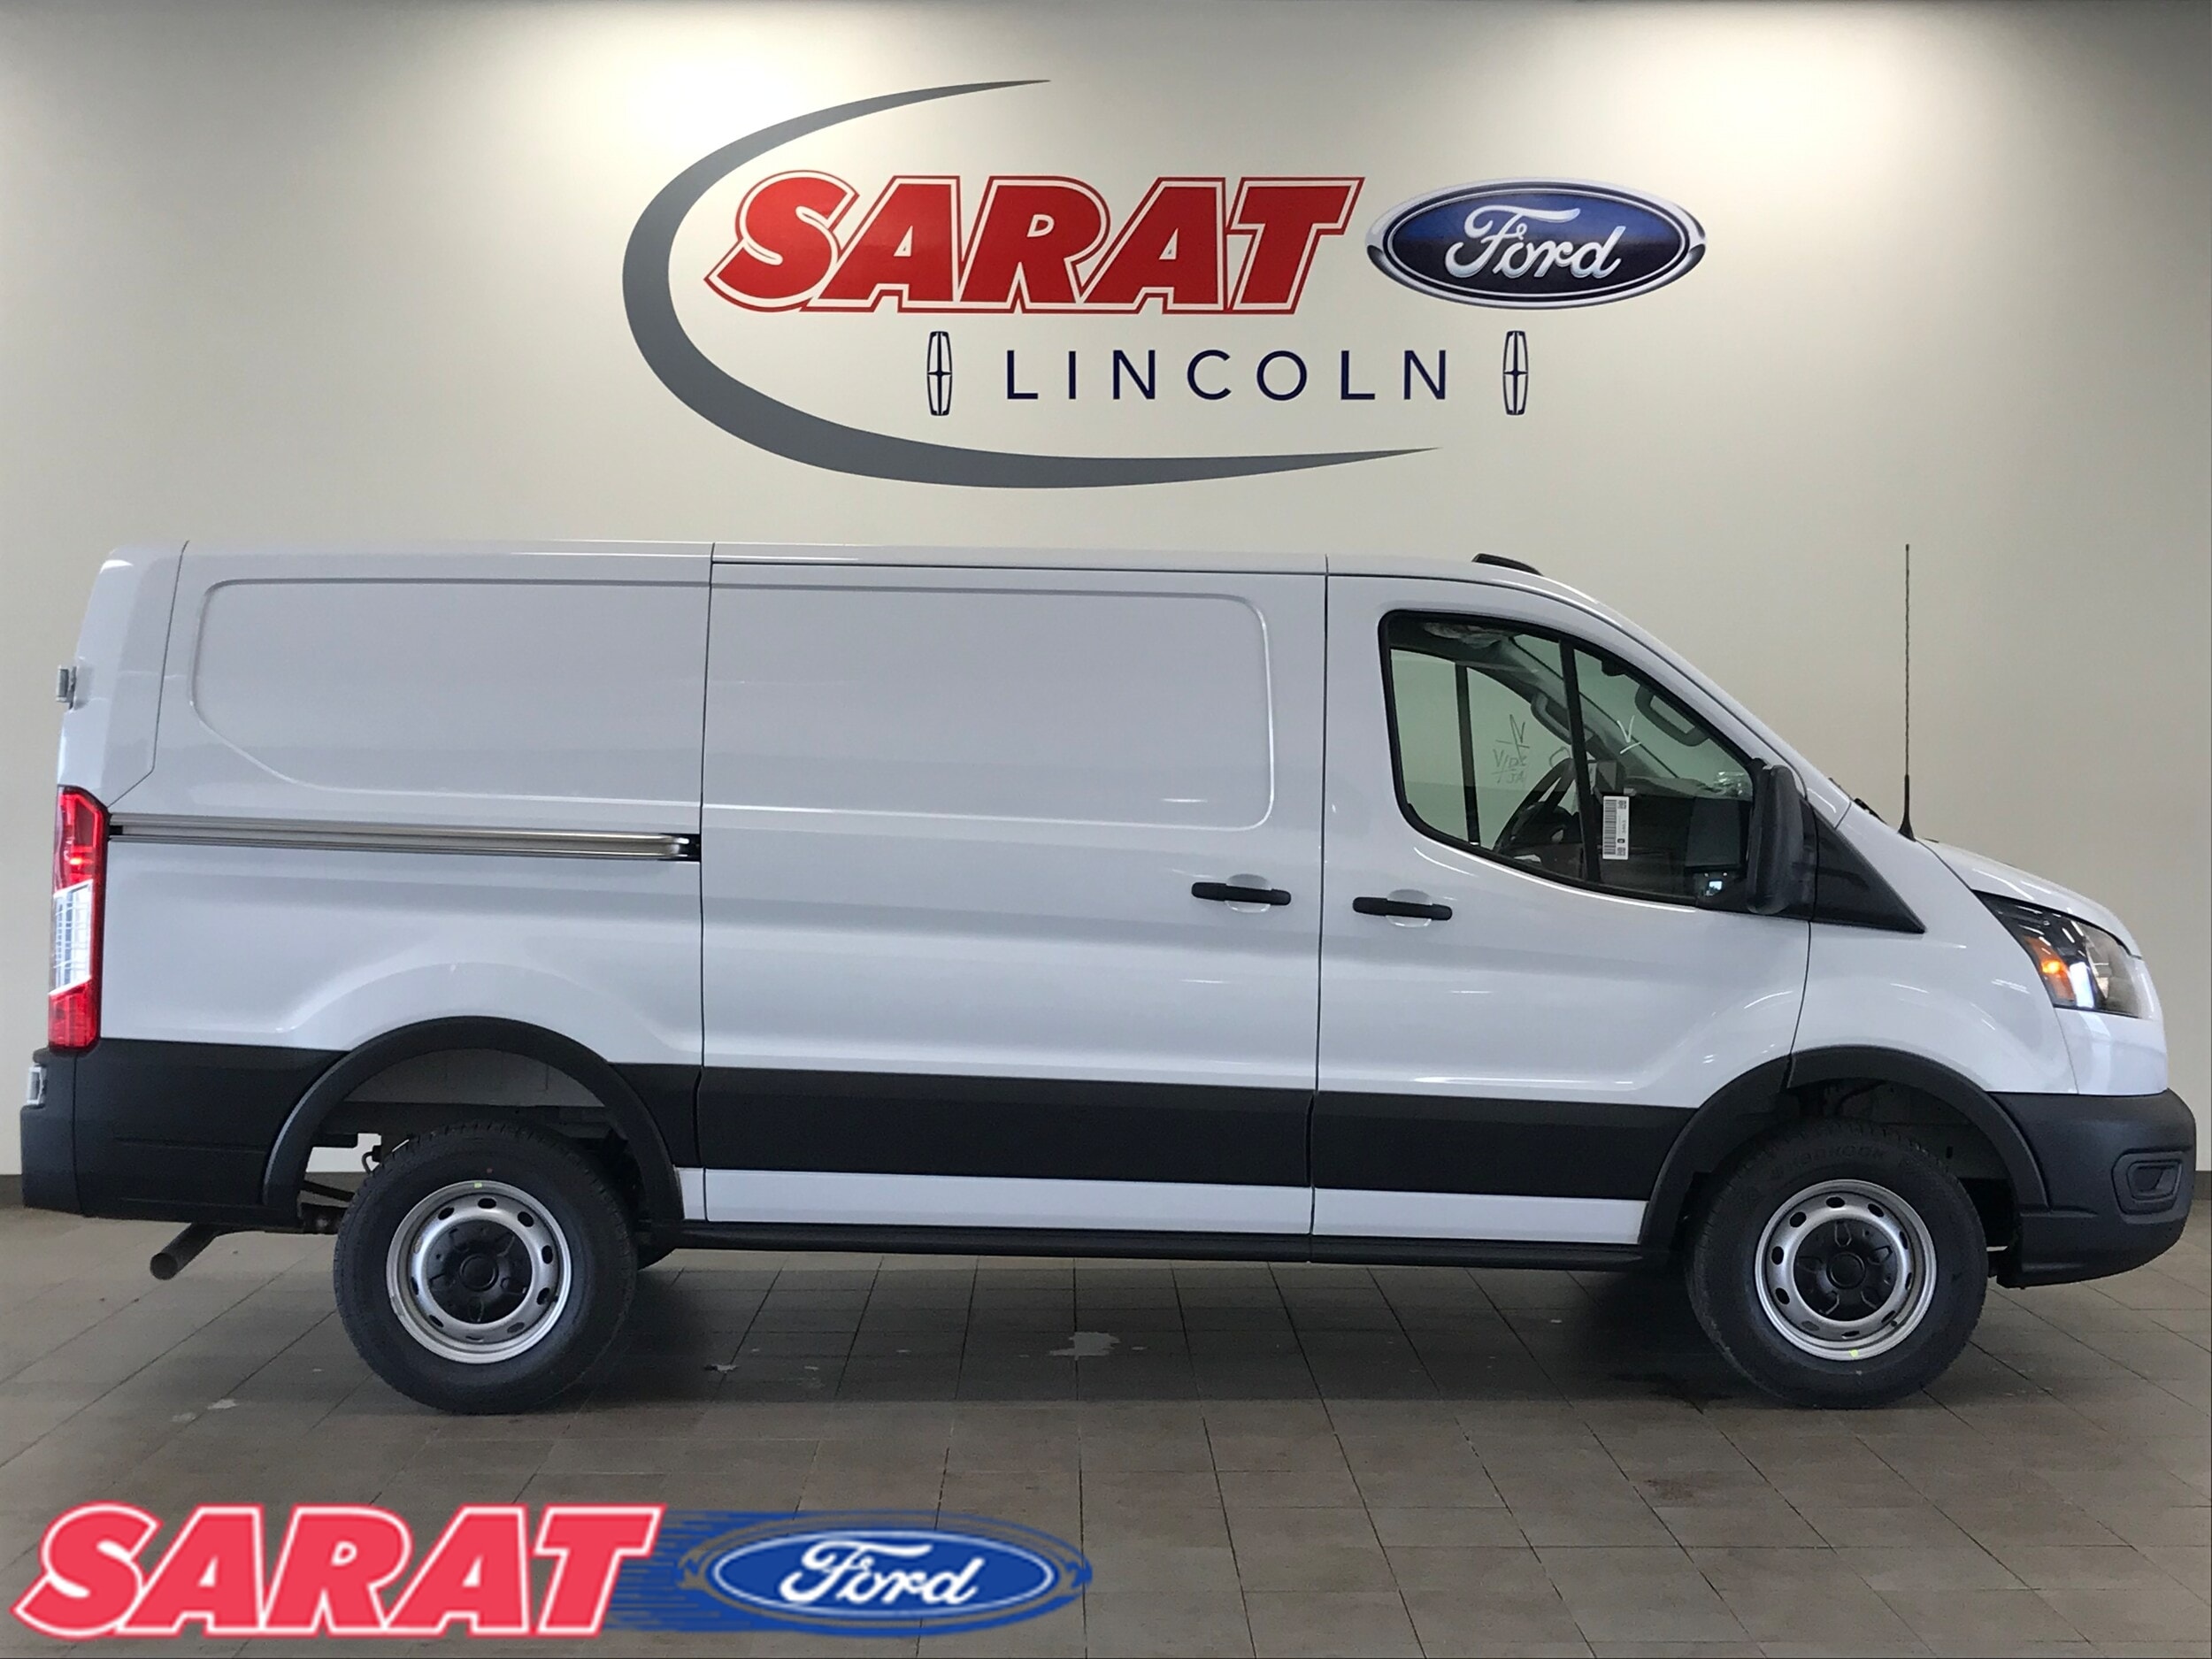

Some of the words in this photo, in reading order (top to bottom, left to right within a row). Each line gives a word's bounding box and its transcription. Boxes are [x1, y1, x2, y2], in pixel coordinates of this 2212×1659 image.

[706, 170, 1364, 314] SARAT
[1444, 204, 1627, 280] Ford
[1005, 349, 1447, 402] LINCOLN
